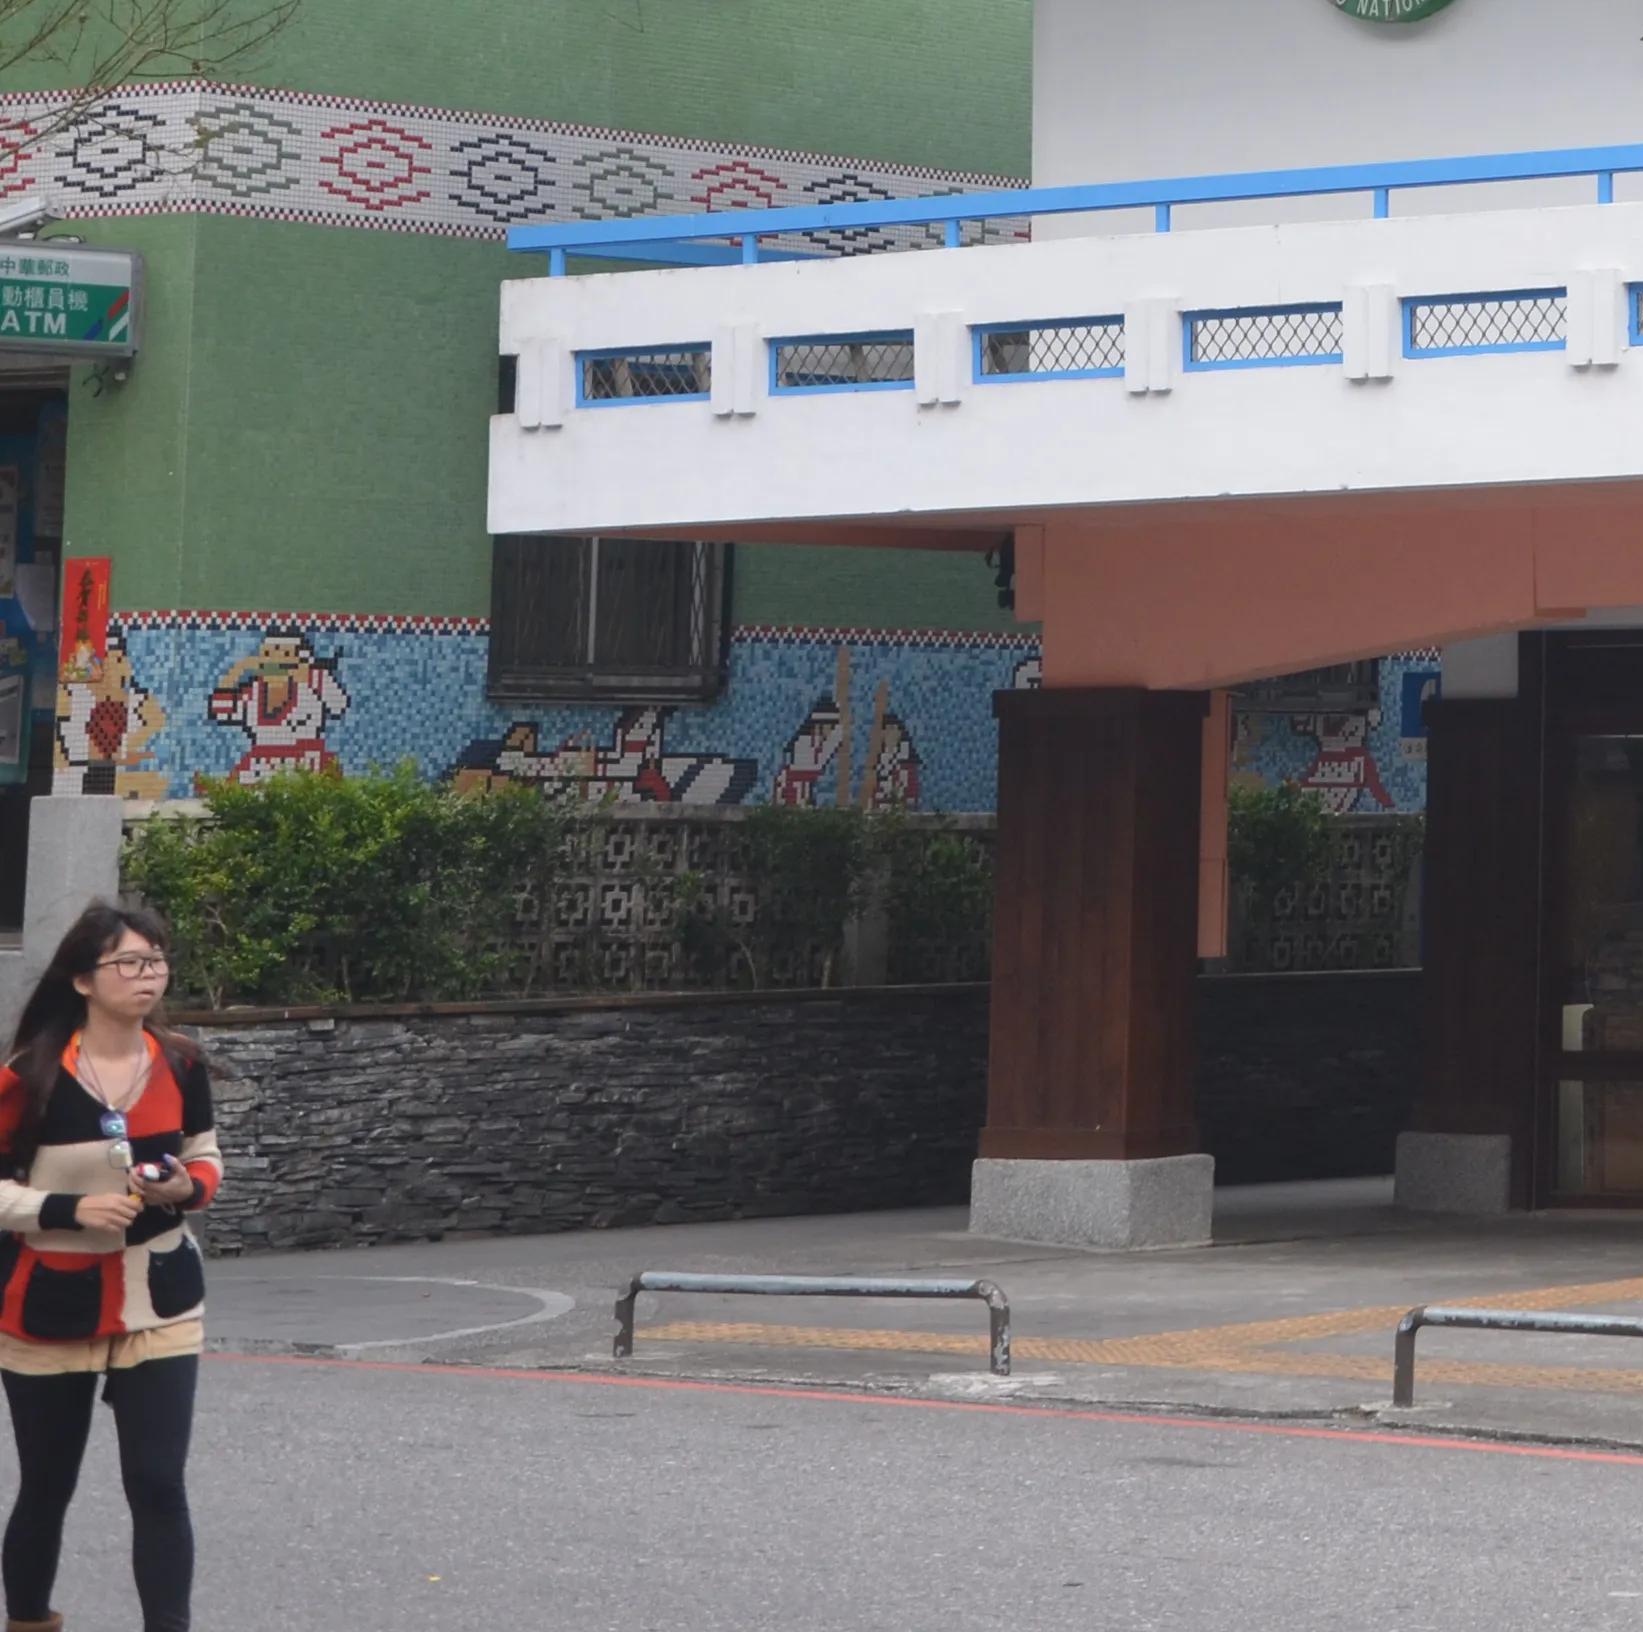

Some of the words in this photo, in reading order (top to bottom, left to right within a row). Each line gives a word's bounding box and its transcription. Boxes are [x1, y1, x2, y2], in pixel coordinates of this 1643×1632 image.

[0, 256, 70, 278] 中華郵政
[1, 309, 67, 335] ATM
